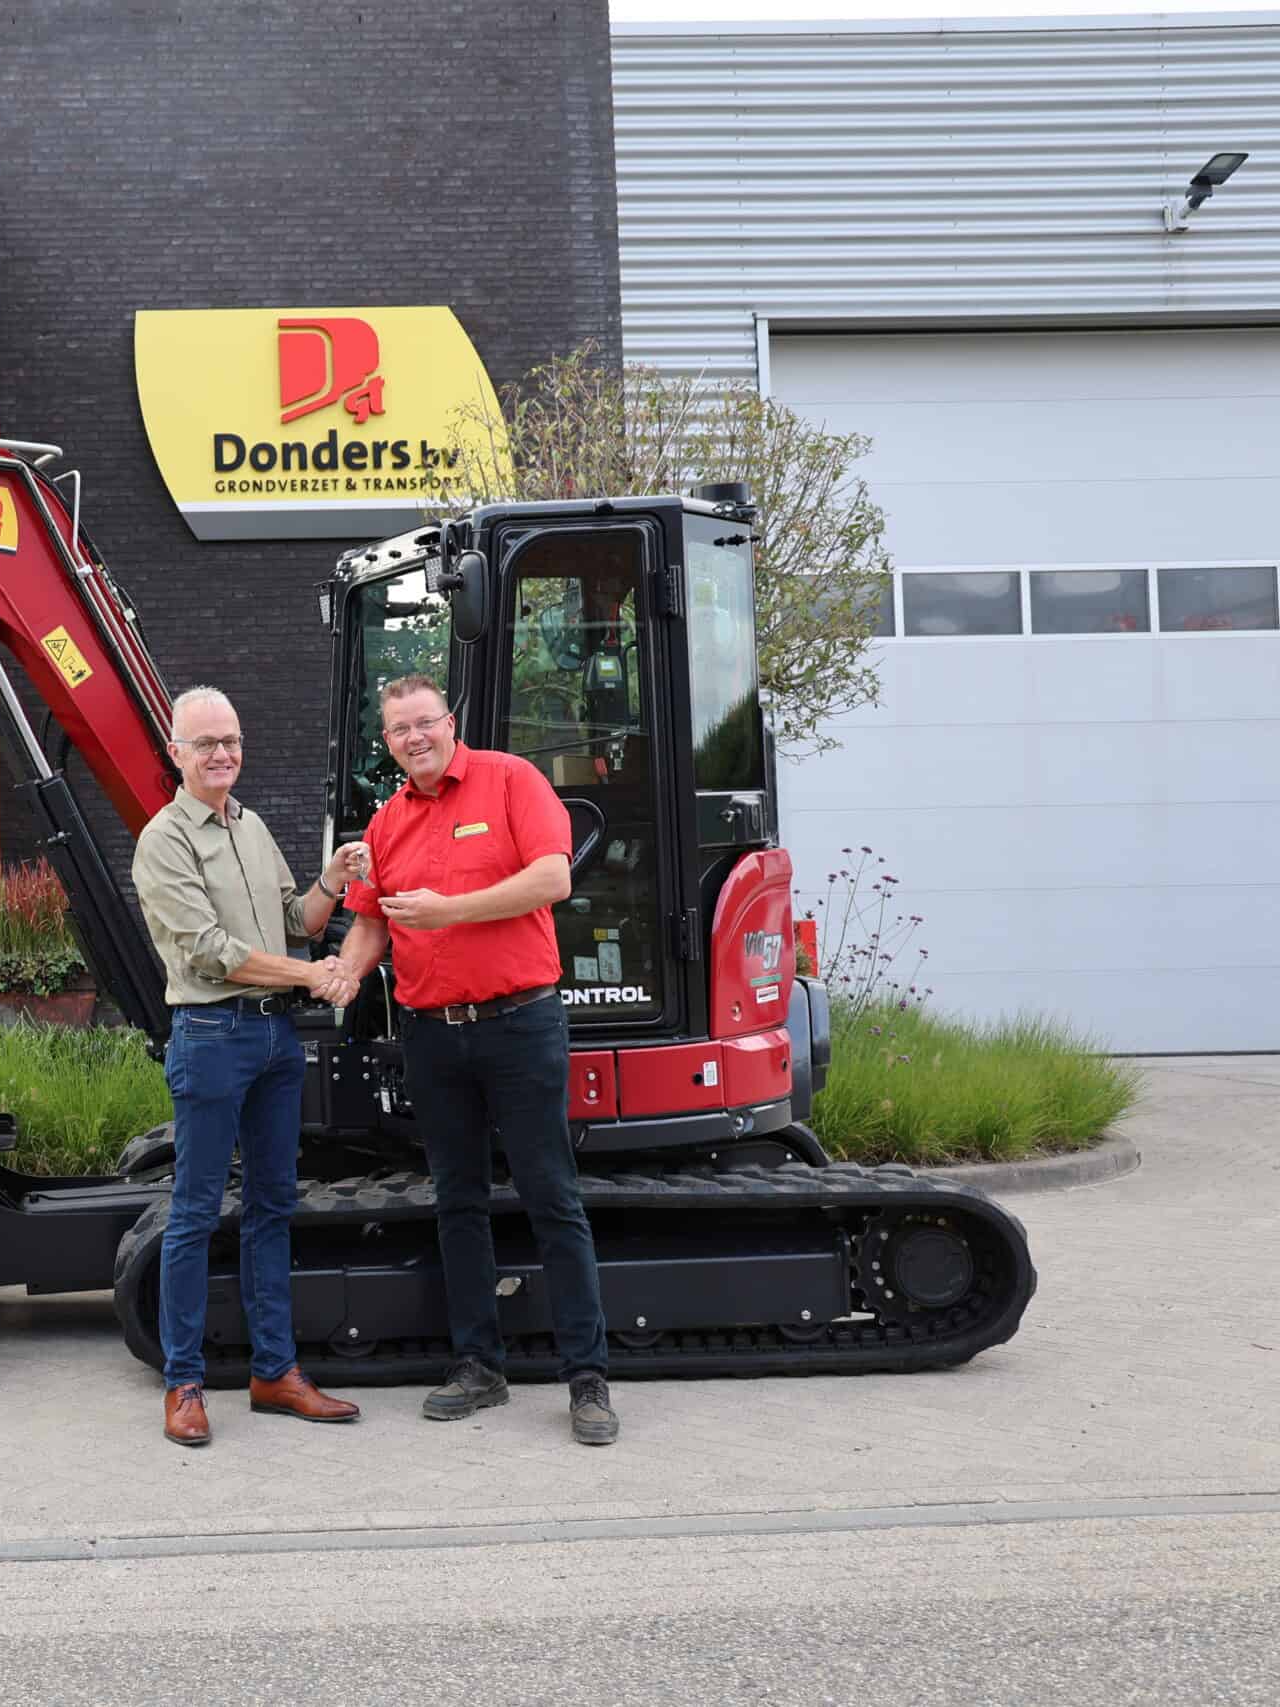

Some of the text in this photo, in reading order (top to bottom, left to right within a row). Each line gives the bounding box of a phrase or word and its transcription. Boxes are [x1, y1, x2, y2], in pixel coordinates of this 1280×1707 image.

[213, 429, 411, 473] Donders
[215, 475, 462, 493] GRONDVERZET & TRANSPORT
[560, 985, 652, 1005] ONTROL
